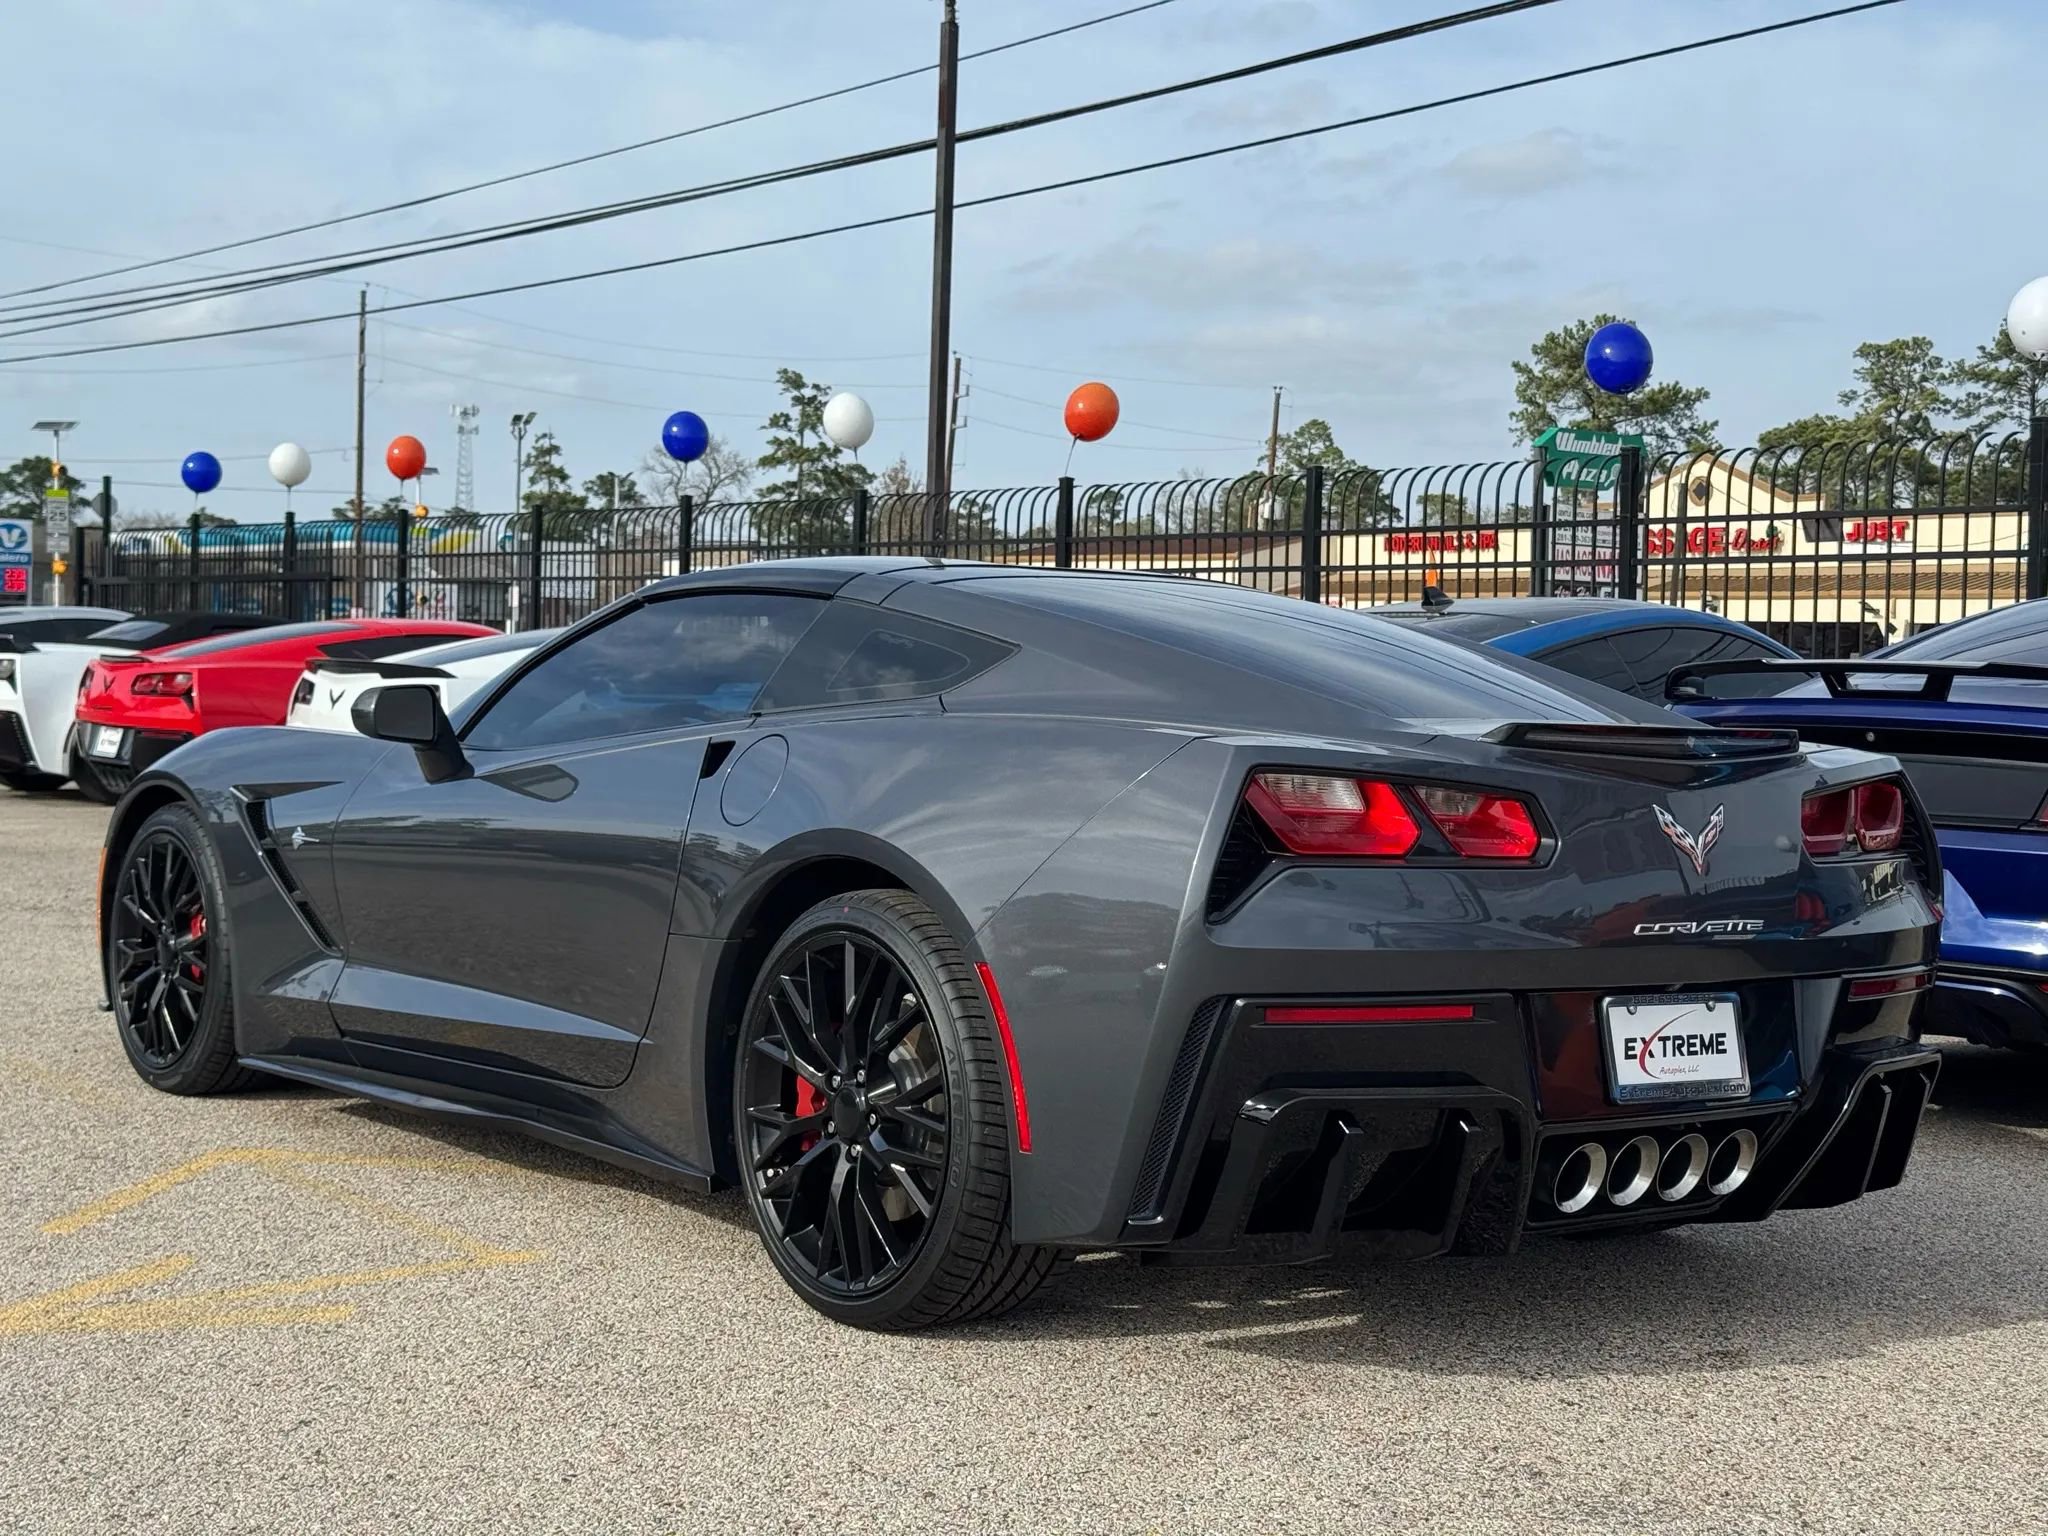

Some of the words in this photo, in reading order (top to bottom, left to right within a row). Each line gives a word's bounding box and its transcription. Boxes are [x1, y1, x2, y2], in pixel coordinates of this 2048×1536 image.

[1555, 431, 1622, 456] Wimbled
[1846, 520, 1910, 543] JUST
[1427, 534, 1463, 552] NAIL
[0, 553, 29, 564] alero
[1633, 919, 1765, 936] CORVETTE
[1624, 1032, 1728, 1060] EXTREME
[1687, 1064, 1701, 1074] LLC
